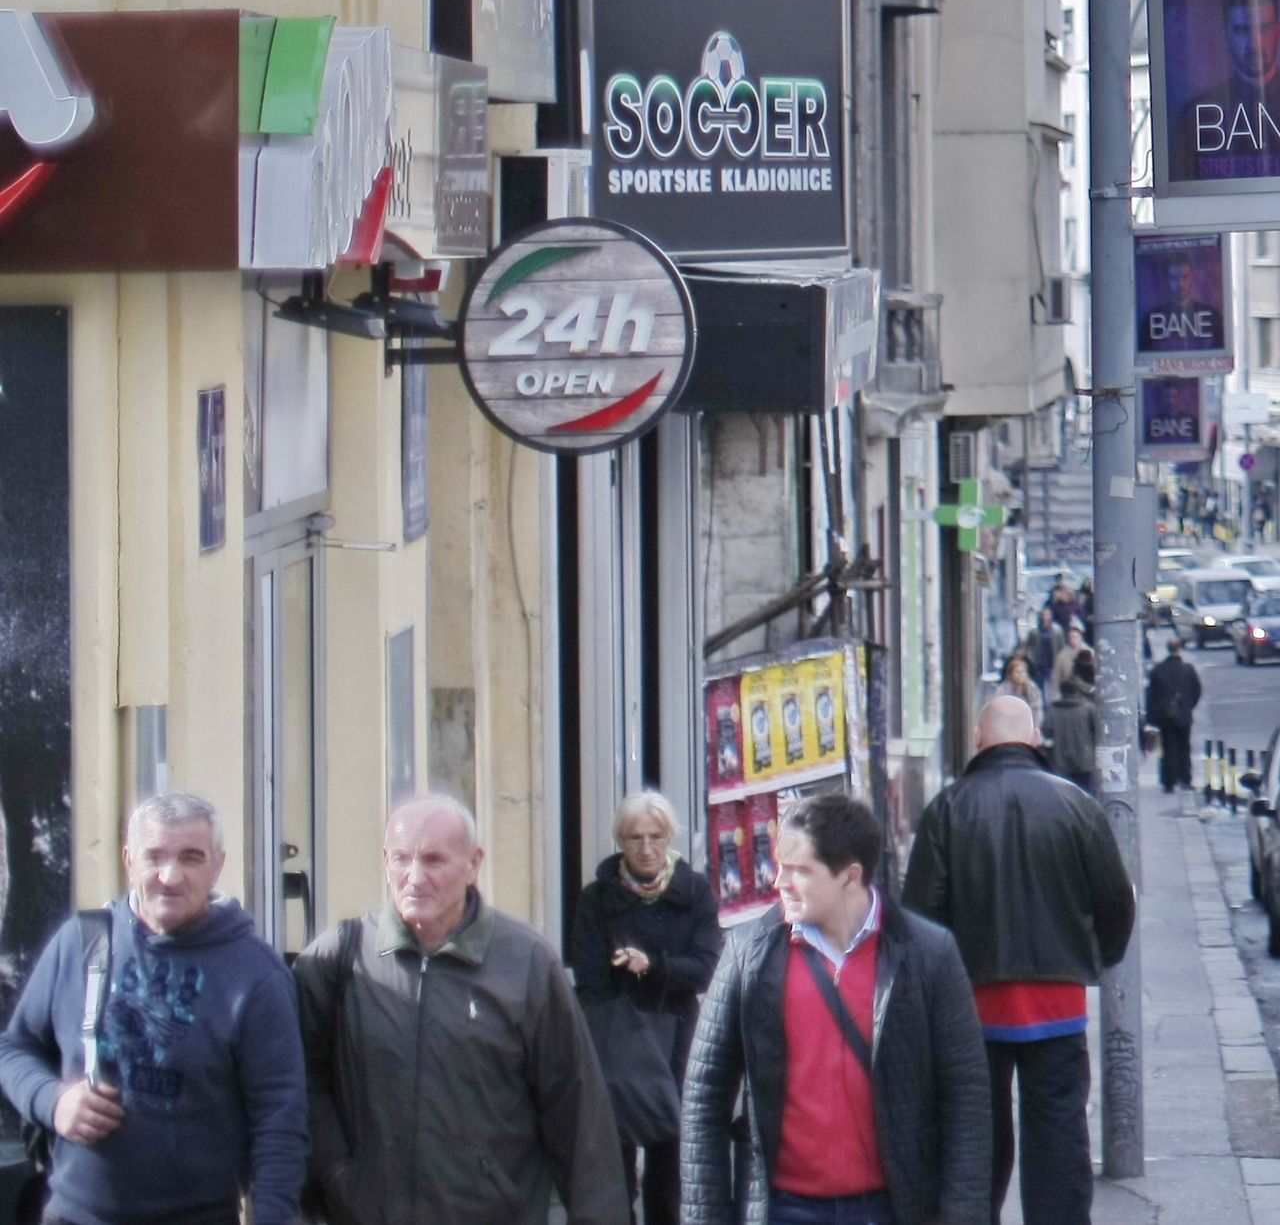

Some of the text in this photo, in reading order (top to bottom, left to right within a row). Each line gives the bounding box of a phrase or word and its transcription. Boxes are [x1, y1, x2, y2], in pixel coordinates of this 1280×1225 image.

[603, 74, 831, 161] SOCCER
[608, 166, 833, 194] SPORTSKE KLADIONICE
[488, 291, 656, 356] 24h
[1149, 310, 1213, 340] BANE
[516, 367, 616, 397] OPEN
[1150, 416, 1193, 438] BANE
